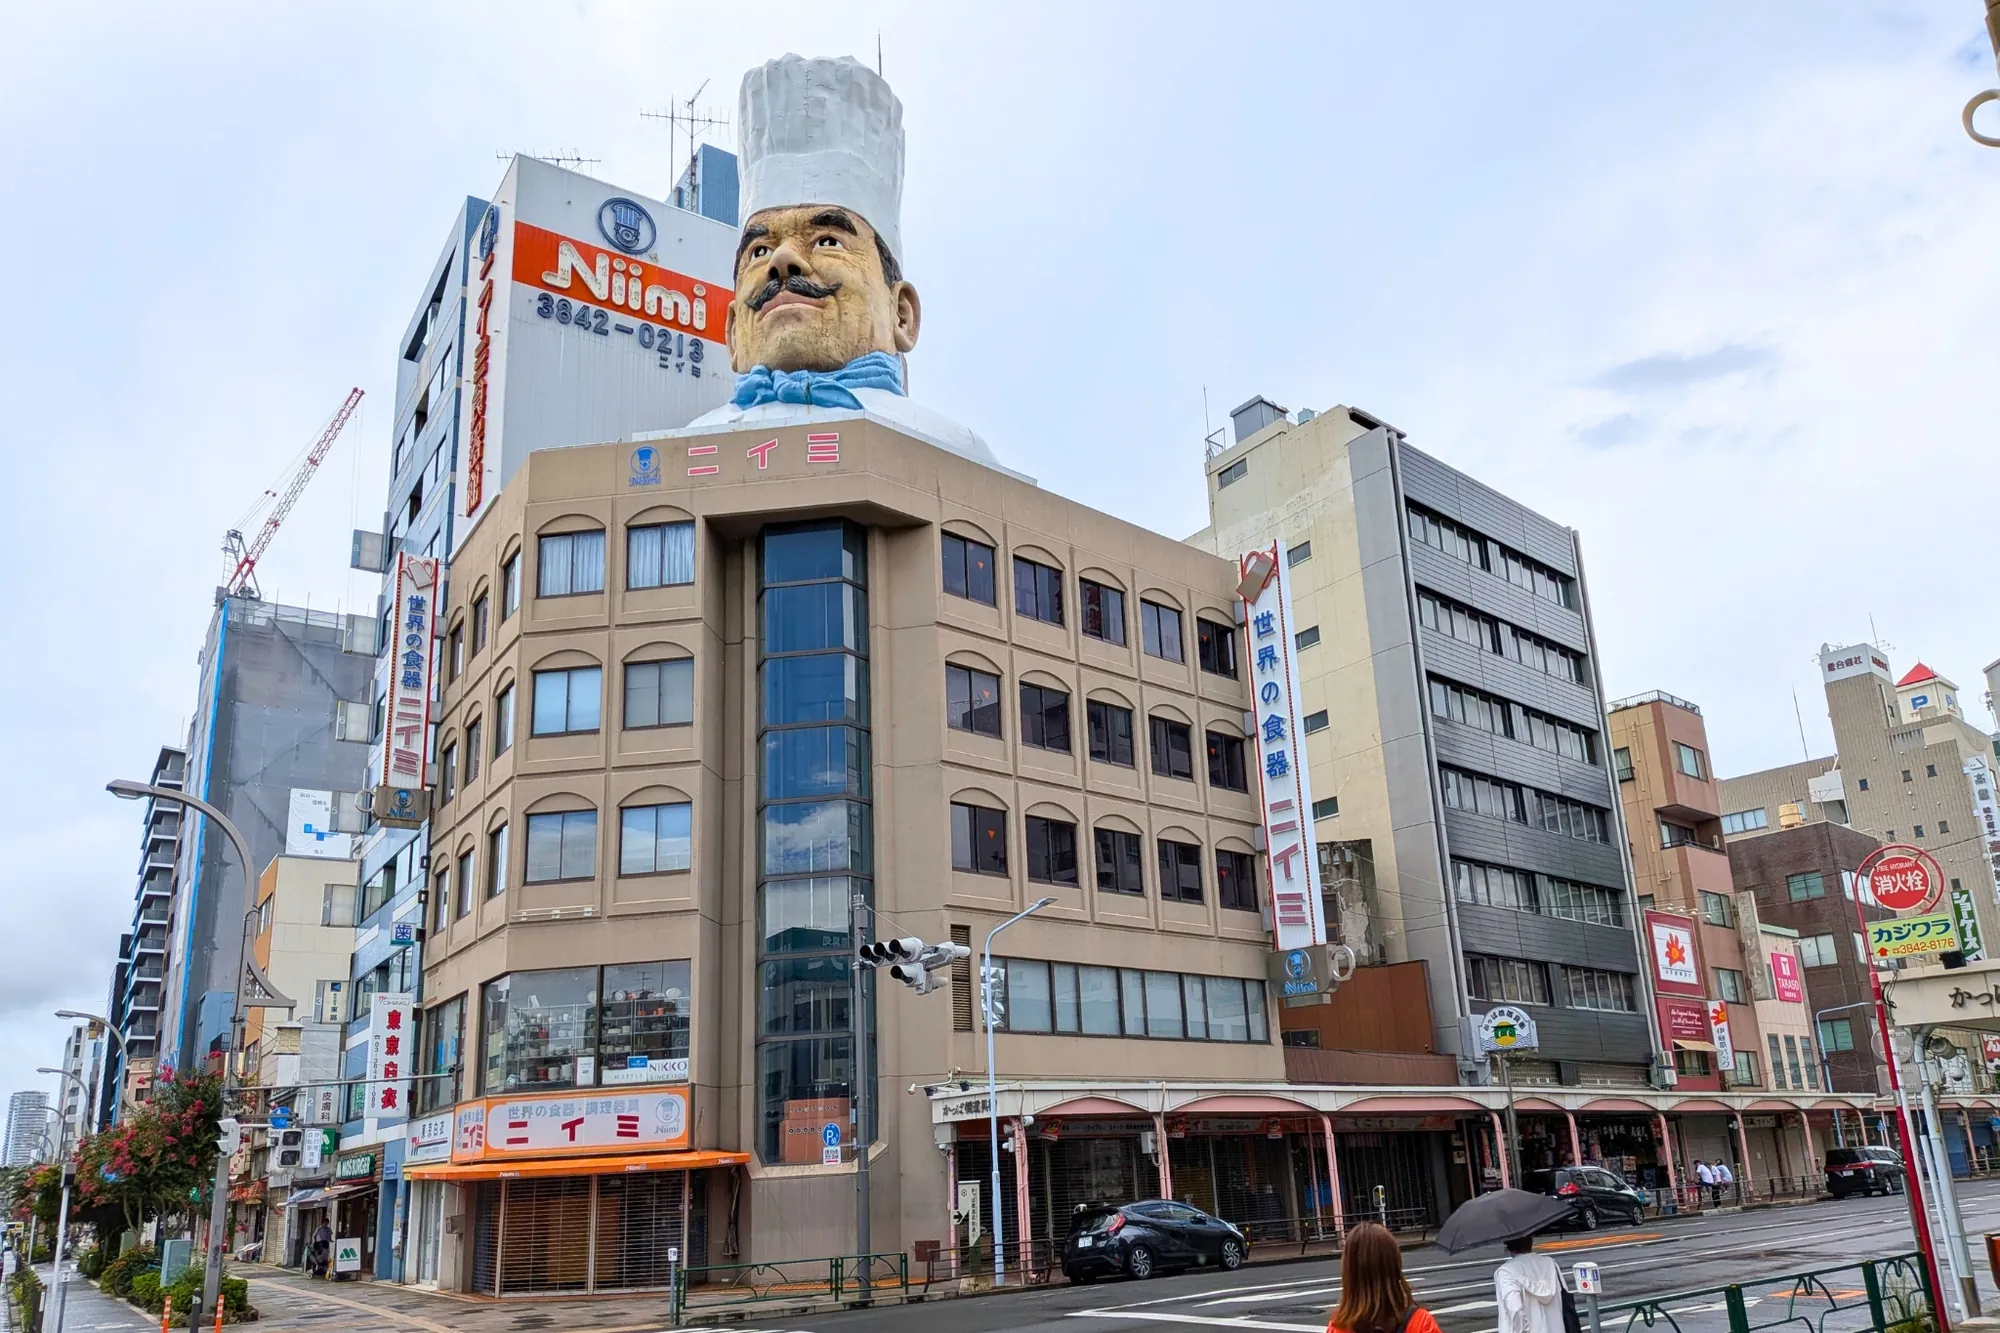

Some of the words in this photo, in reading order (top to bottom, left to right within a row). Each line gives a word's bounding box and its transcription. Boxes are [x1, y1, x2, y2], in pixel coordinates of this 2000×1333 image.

[541, 240, 706, 331] Niimi
[537, 292, 704, 363] 3842-0213
[659, 356, 702, 378] ニイミ
[688, 433, 839, 476] ニイミ
[401, 595, 427, 690] 世界の食器
[1254, 610, 1289, 779] 世界の食器
[1911, 694, 1929, 710] P
[392, 697, 422, 776] ニイミ
[1270, 799, 1307, 926] ニイミ
[1877, 864, 1889, 873] FIRE
[1890, 860, 1915, 870] HYDRANT
[1874, 869, 1926, 895] 消火栓
[395, 924, 412, 940] 歯
[1873, 918, 1950, 943] カジワラ
[1953, 892, 1980, 950] ショーケース
[1900, 937, 1954, 954] 3842-8176
[1284, 978, 1318, 996] Niimi
[381, 1009, 401, 1109] 東京白衣
[649, 1061, 687, 1072] NIKKO
[320, 1091, 332, 1122] 皮膚科
[507, 1099, 639, 1120] 世界の食器・調理器具
[506, 1115, 639, 1145] ニイミ
[654, 1124, 680, 1134] Niimi
